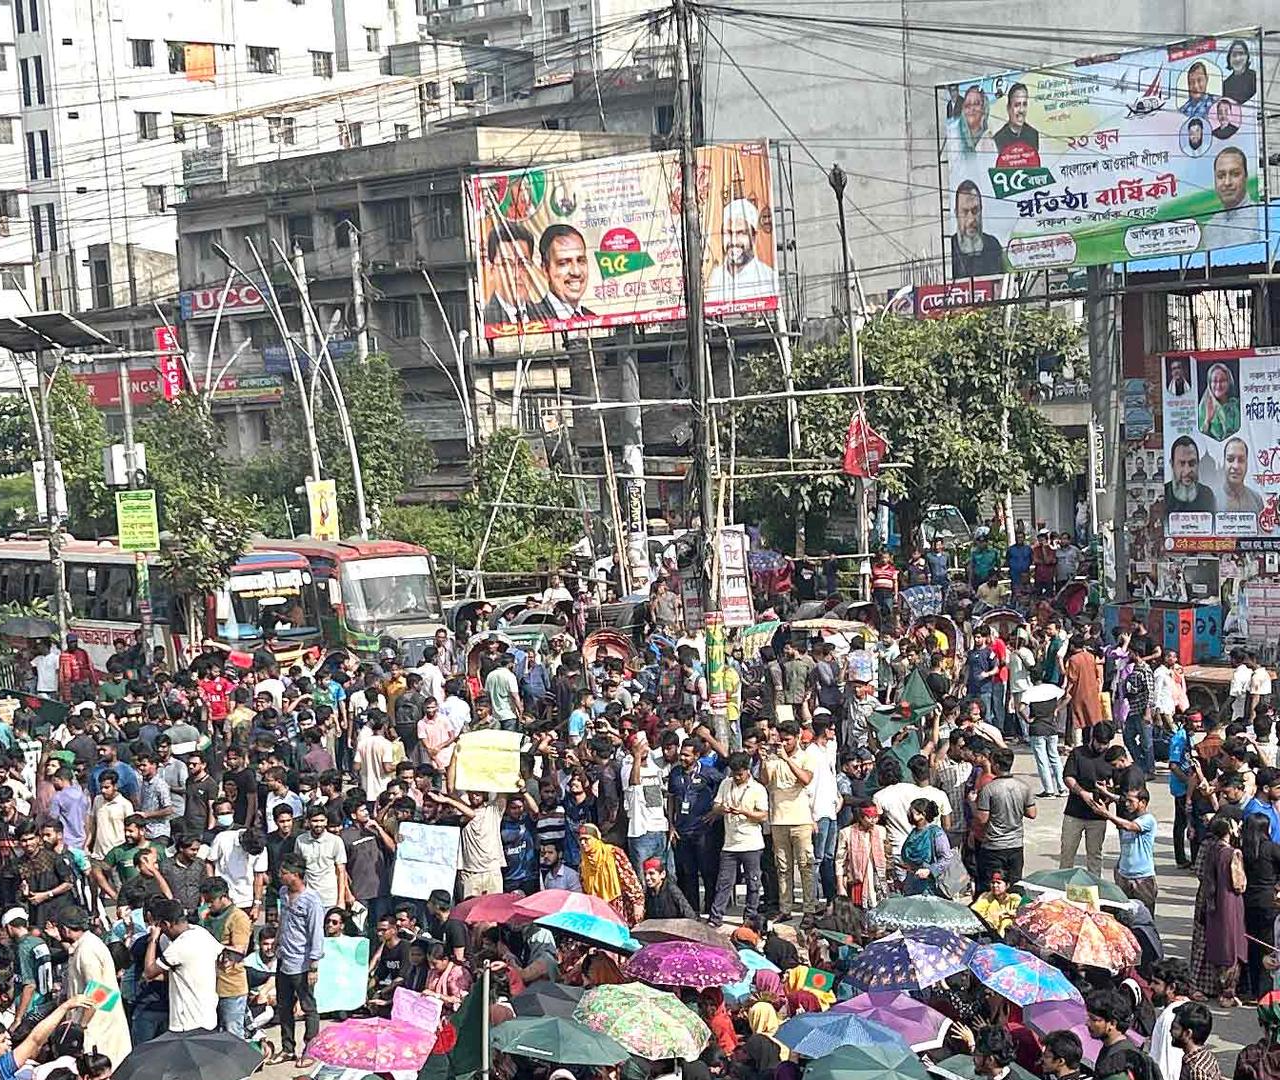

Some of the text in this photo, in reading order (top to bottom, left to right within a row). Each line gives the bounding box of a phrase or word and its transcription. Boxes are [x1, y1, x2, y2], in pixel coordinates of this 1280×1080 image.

[1060, 161, 1099, 179] বাংলাদেশ
[1102, 153, 1139, 175] আওয়ামী
[992, 169, 1026, 192] ৭৫
[1017, 172, 1178, 218] প্রতিষ্ঠা বার্ষিকী
[600, 256, 629, 274] ৭৫
